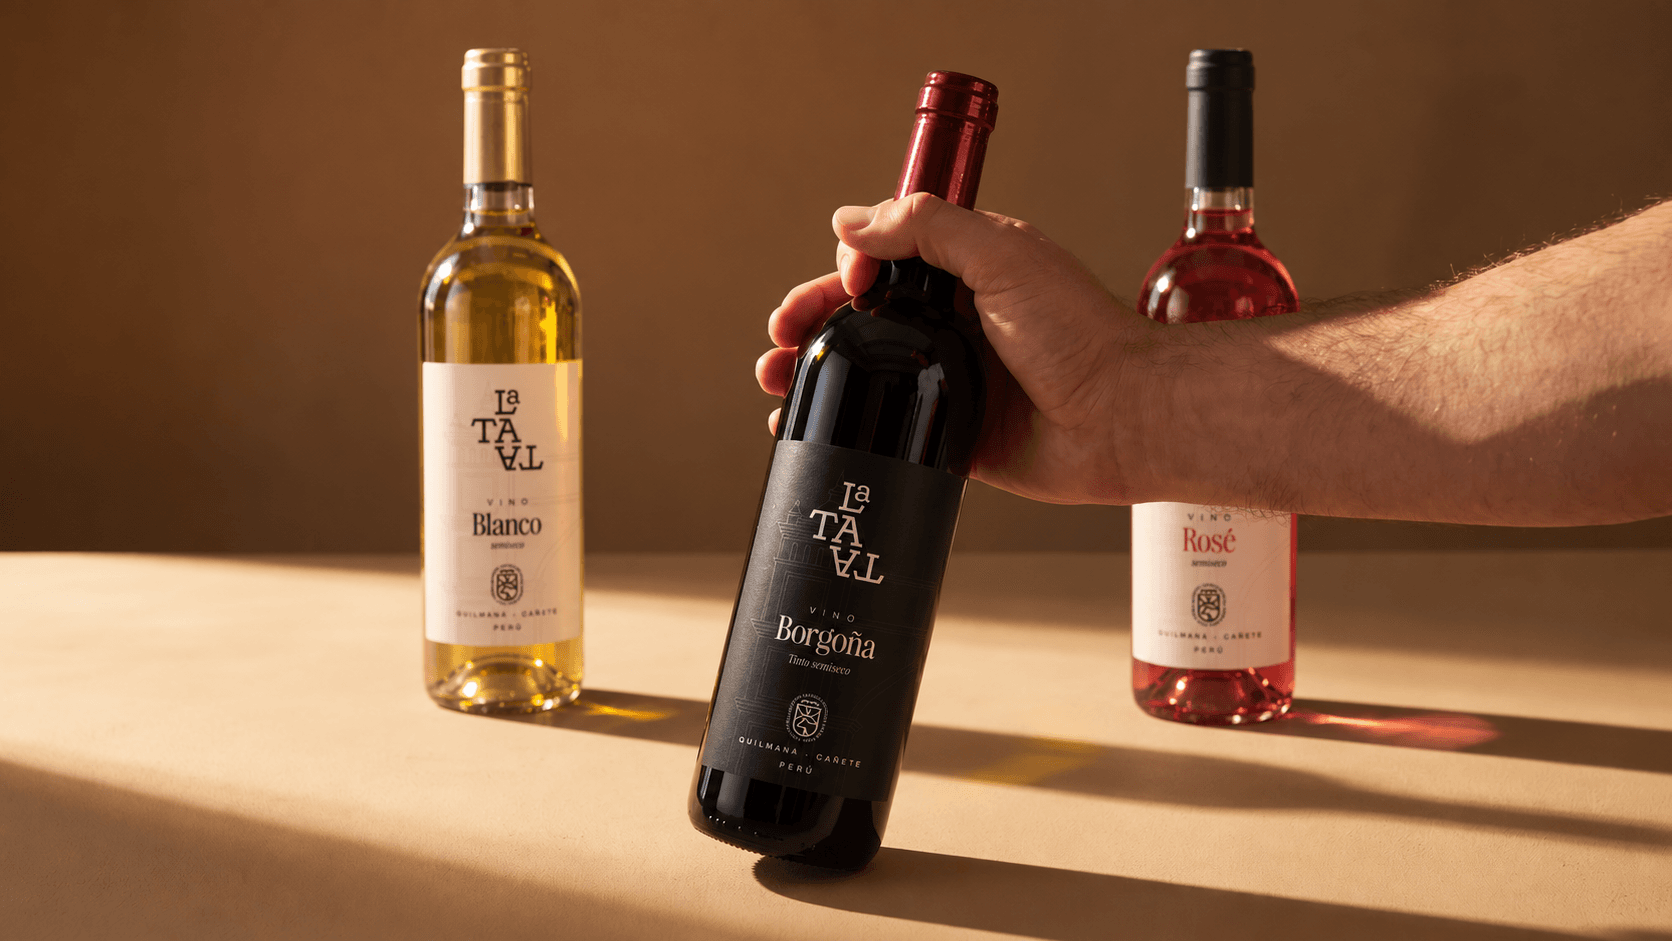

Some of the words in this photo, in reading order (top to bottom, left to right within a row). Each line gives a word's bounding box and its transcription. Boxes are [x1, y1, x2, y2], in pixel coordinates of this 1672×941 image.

[494, 389, 520, 415] La
[471, 418, 522, 443] TA
[487, 498, 528, 506] VINO
[838, 481, 871, 514] La
[472, 512, 542, 536] Blanco
[809, 509, 863, 548] TA
[1187, 513, 1232, 521] VINO
[1183, 527, 1236, 553] Rosé
[810, 606, 855, 623] VINO
[493, 623, 521, 631] PERÚ
[774, 614, 876, 660] Borgoña
[1193, 645, 1223, 654] PERÚ
[788, 653, 811, 668] Tinto
[810, 660, 851, 676] semiseco
[778, 760, 813, 775] PERÚ
[816, 753, 862, 769] CAÑETE
